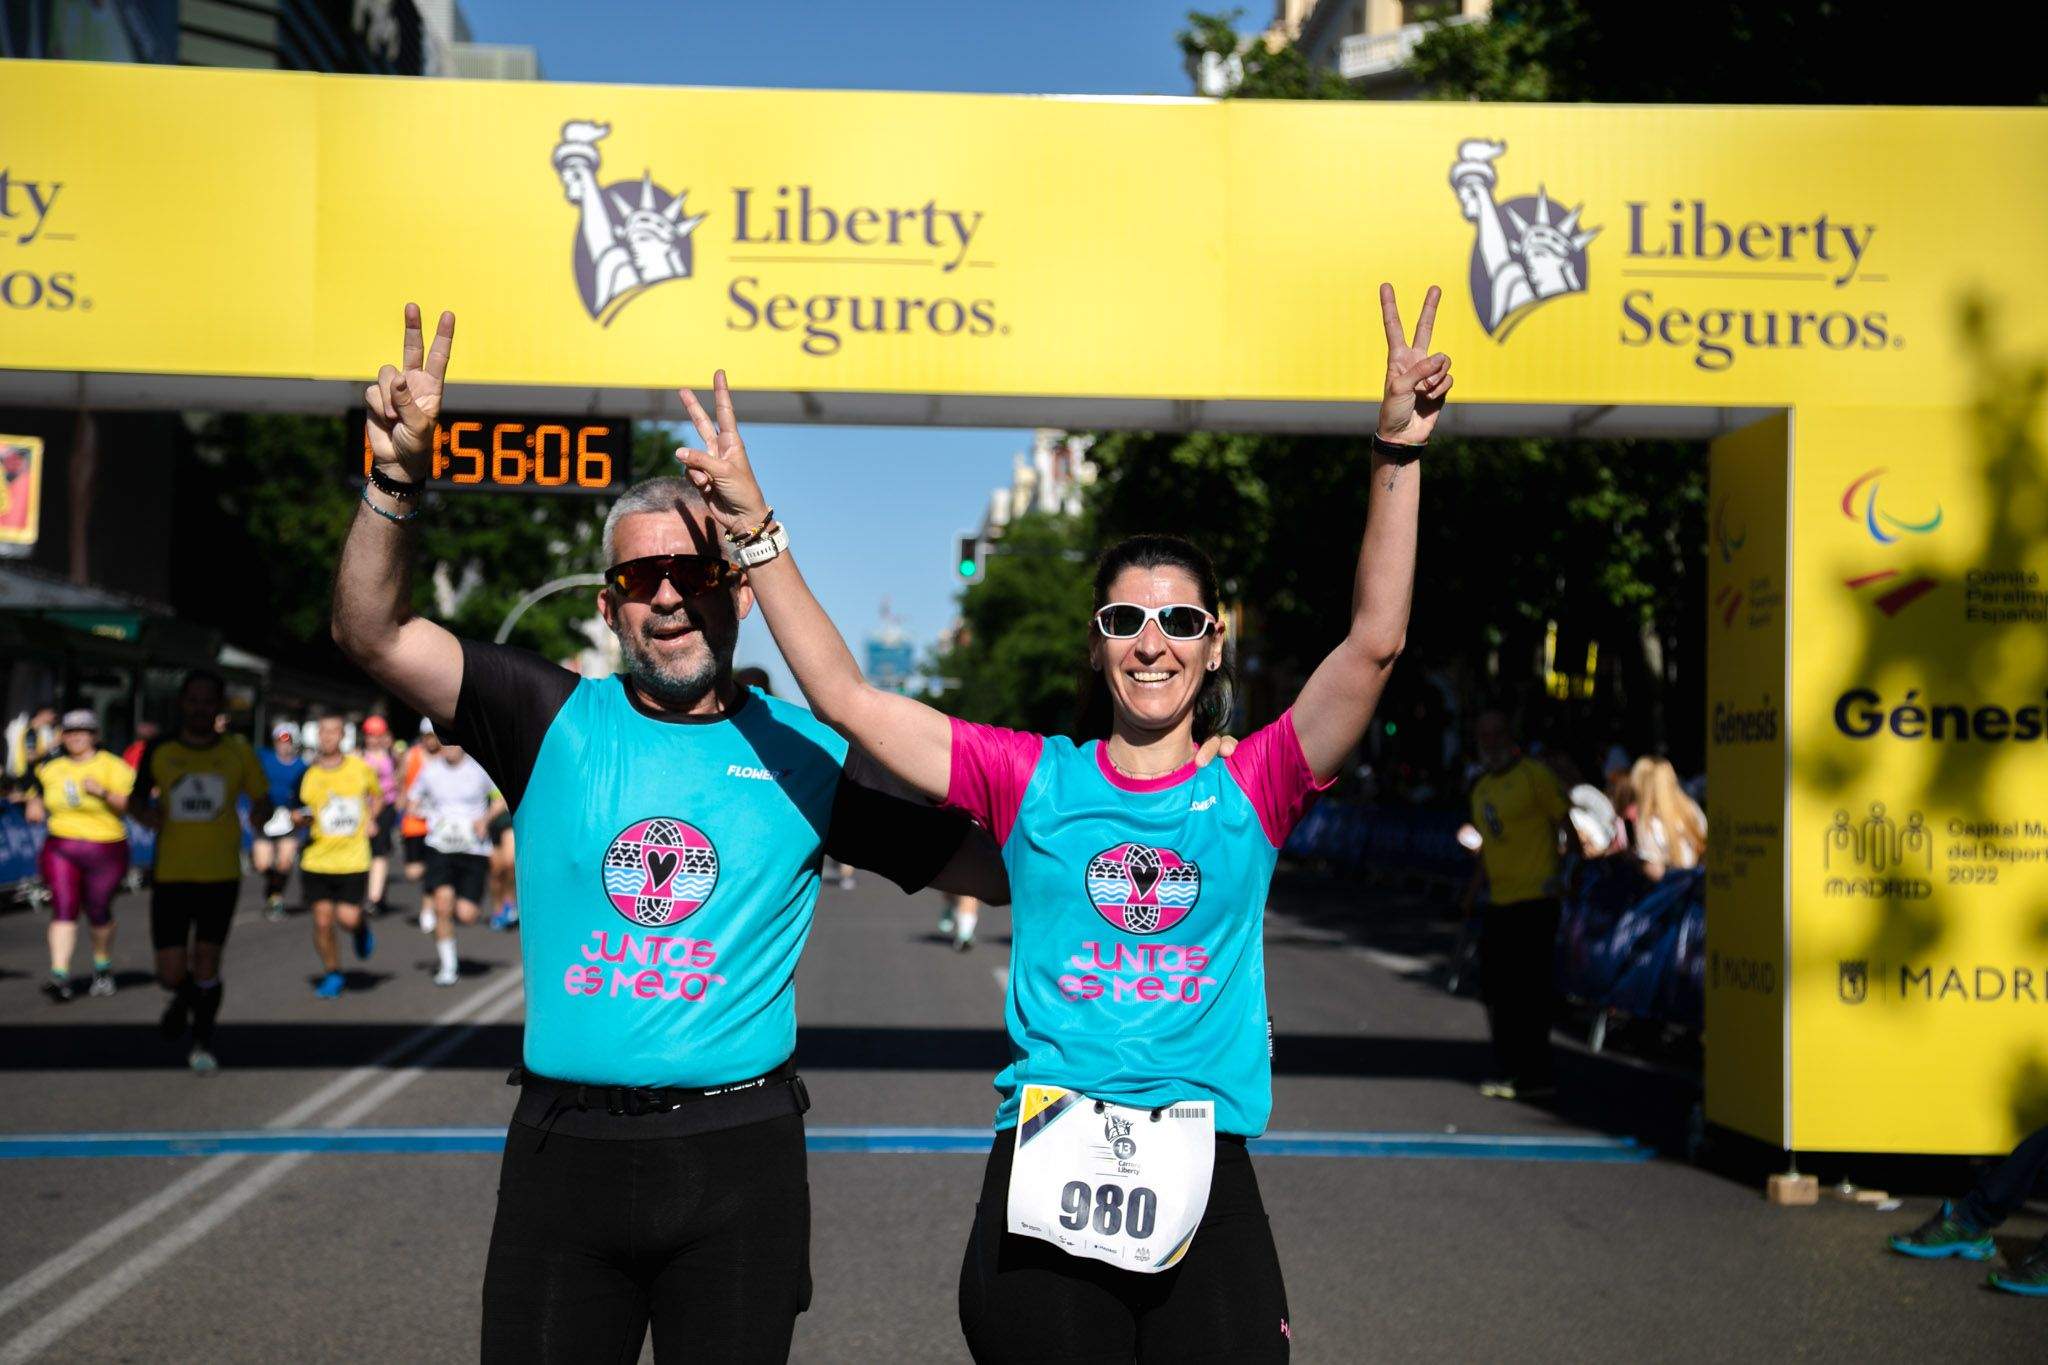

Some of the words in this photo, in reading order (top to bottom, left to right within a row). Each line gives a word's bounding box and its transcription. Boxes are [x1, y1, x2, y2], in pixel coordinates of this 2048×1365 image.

[731, 185, 984, 271] Liberty
[1627, 199, 1876, 287] Liberty
[1834, 688, 2048, 742] Génes
[1948, 818, 2018, 839] Capital
[1949, 843, 1977, 860] del
[1948, 866, 1998, 884] 2022
[1118, 1142, 1132, 1154] 13
[1058, 1180, 1158, 1239] 980
